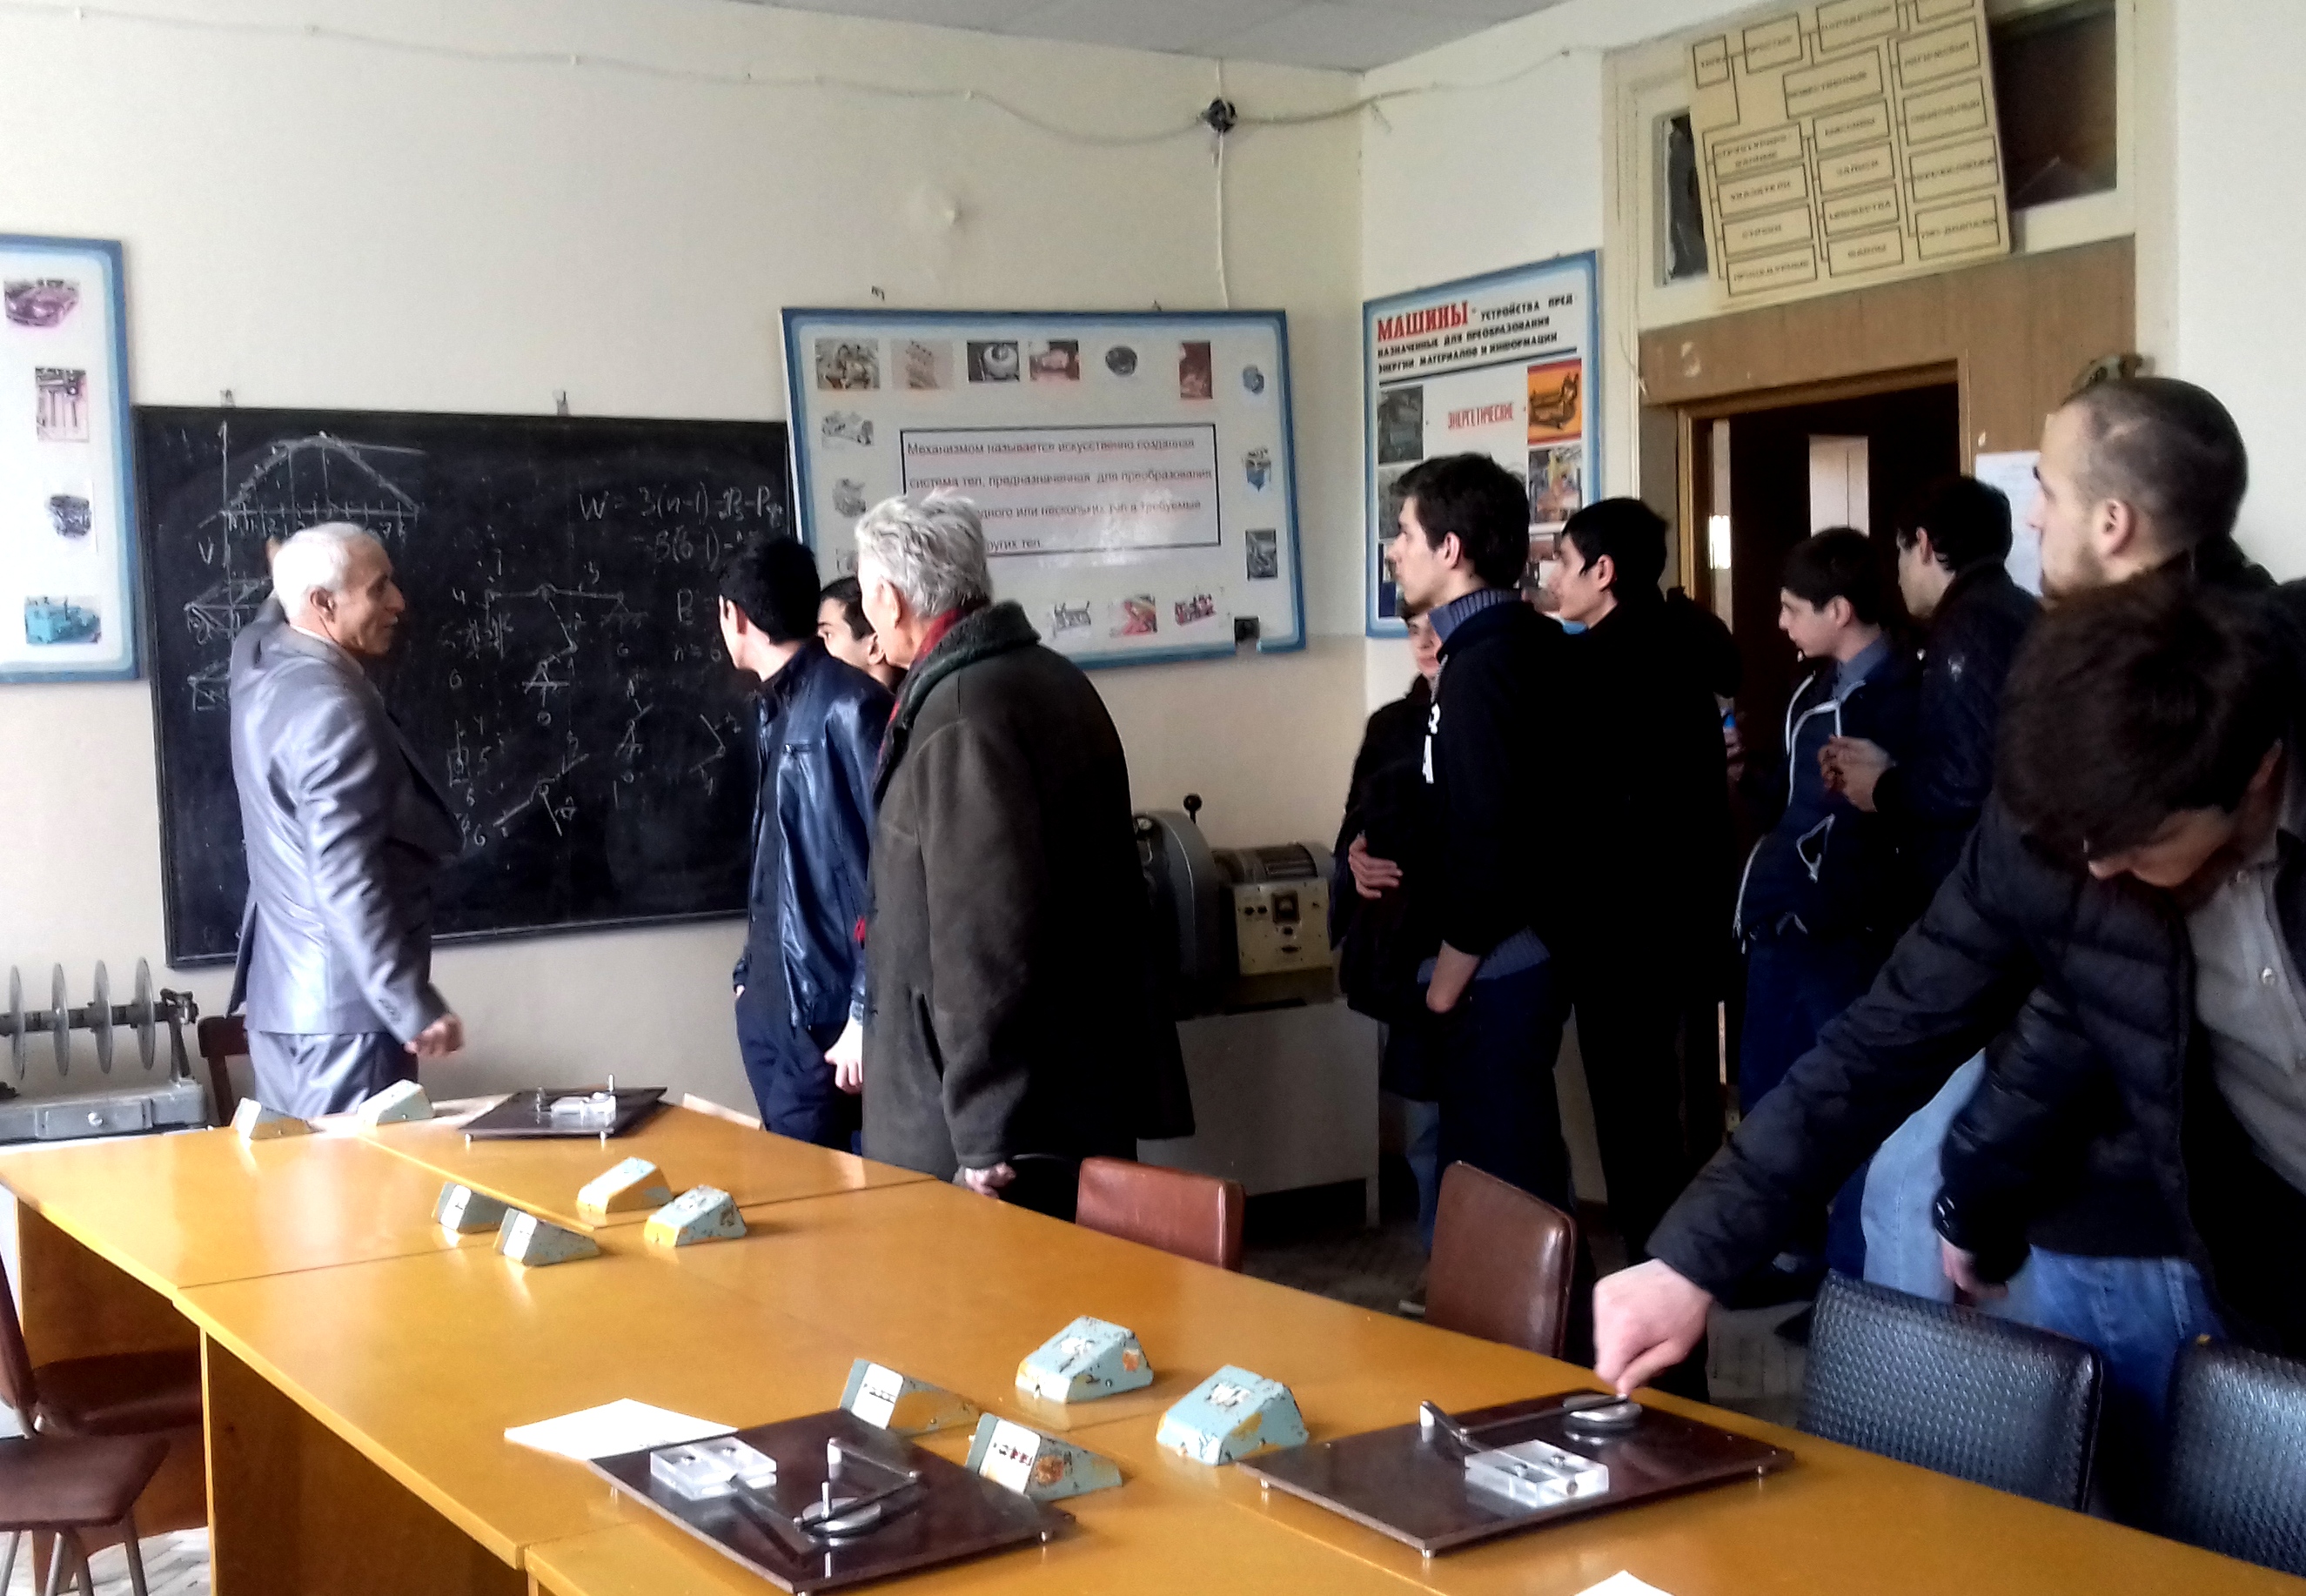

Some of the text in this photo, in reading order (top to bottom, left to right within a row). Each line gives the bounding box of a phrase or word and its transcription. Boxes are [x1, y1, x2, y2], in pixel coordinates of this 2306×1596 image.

[1378, 298, 1468, 342] МАШИНЫ
[1480, 300, 1540, 322] УСТРОЙСТВА
[1378, 316, 1550, 359] НАЗНАЧЕННЫЕ ДЛЯ ПРЕОБРАЗОВАНИЯ
[1419, 346, 1478, 366] МАТЕРИАЛОВ
[1480, 345, 1487, 357] И
[1489, 332, 1559, 354] ИНФОРМАЦИИ
[1447, 401, 1514, 429] ЭНЕРГЕТИЧЕСКИЕ
[908, 439, 1195, 455] Механизмом называется искусственно созданная
[909, 477, 959, 489] система
[989, 473, 1090, 489] предназначенная
[1096, 473, 1118, 484] для
[579, 489, 610, 520] W
[1016, 506, 1038, 518] или
